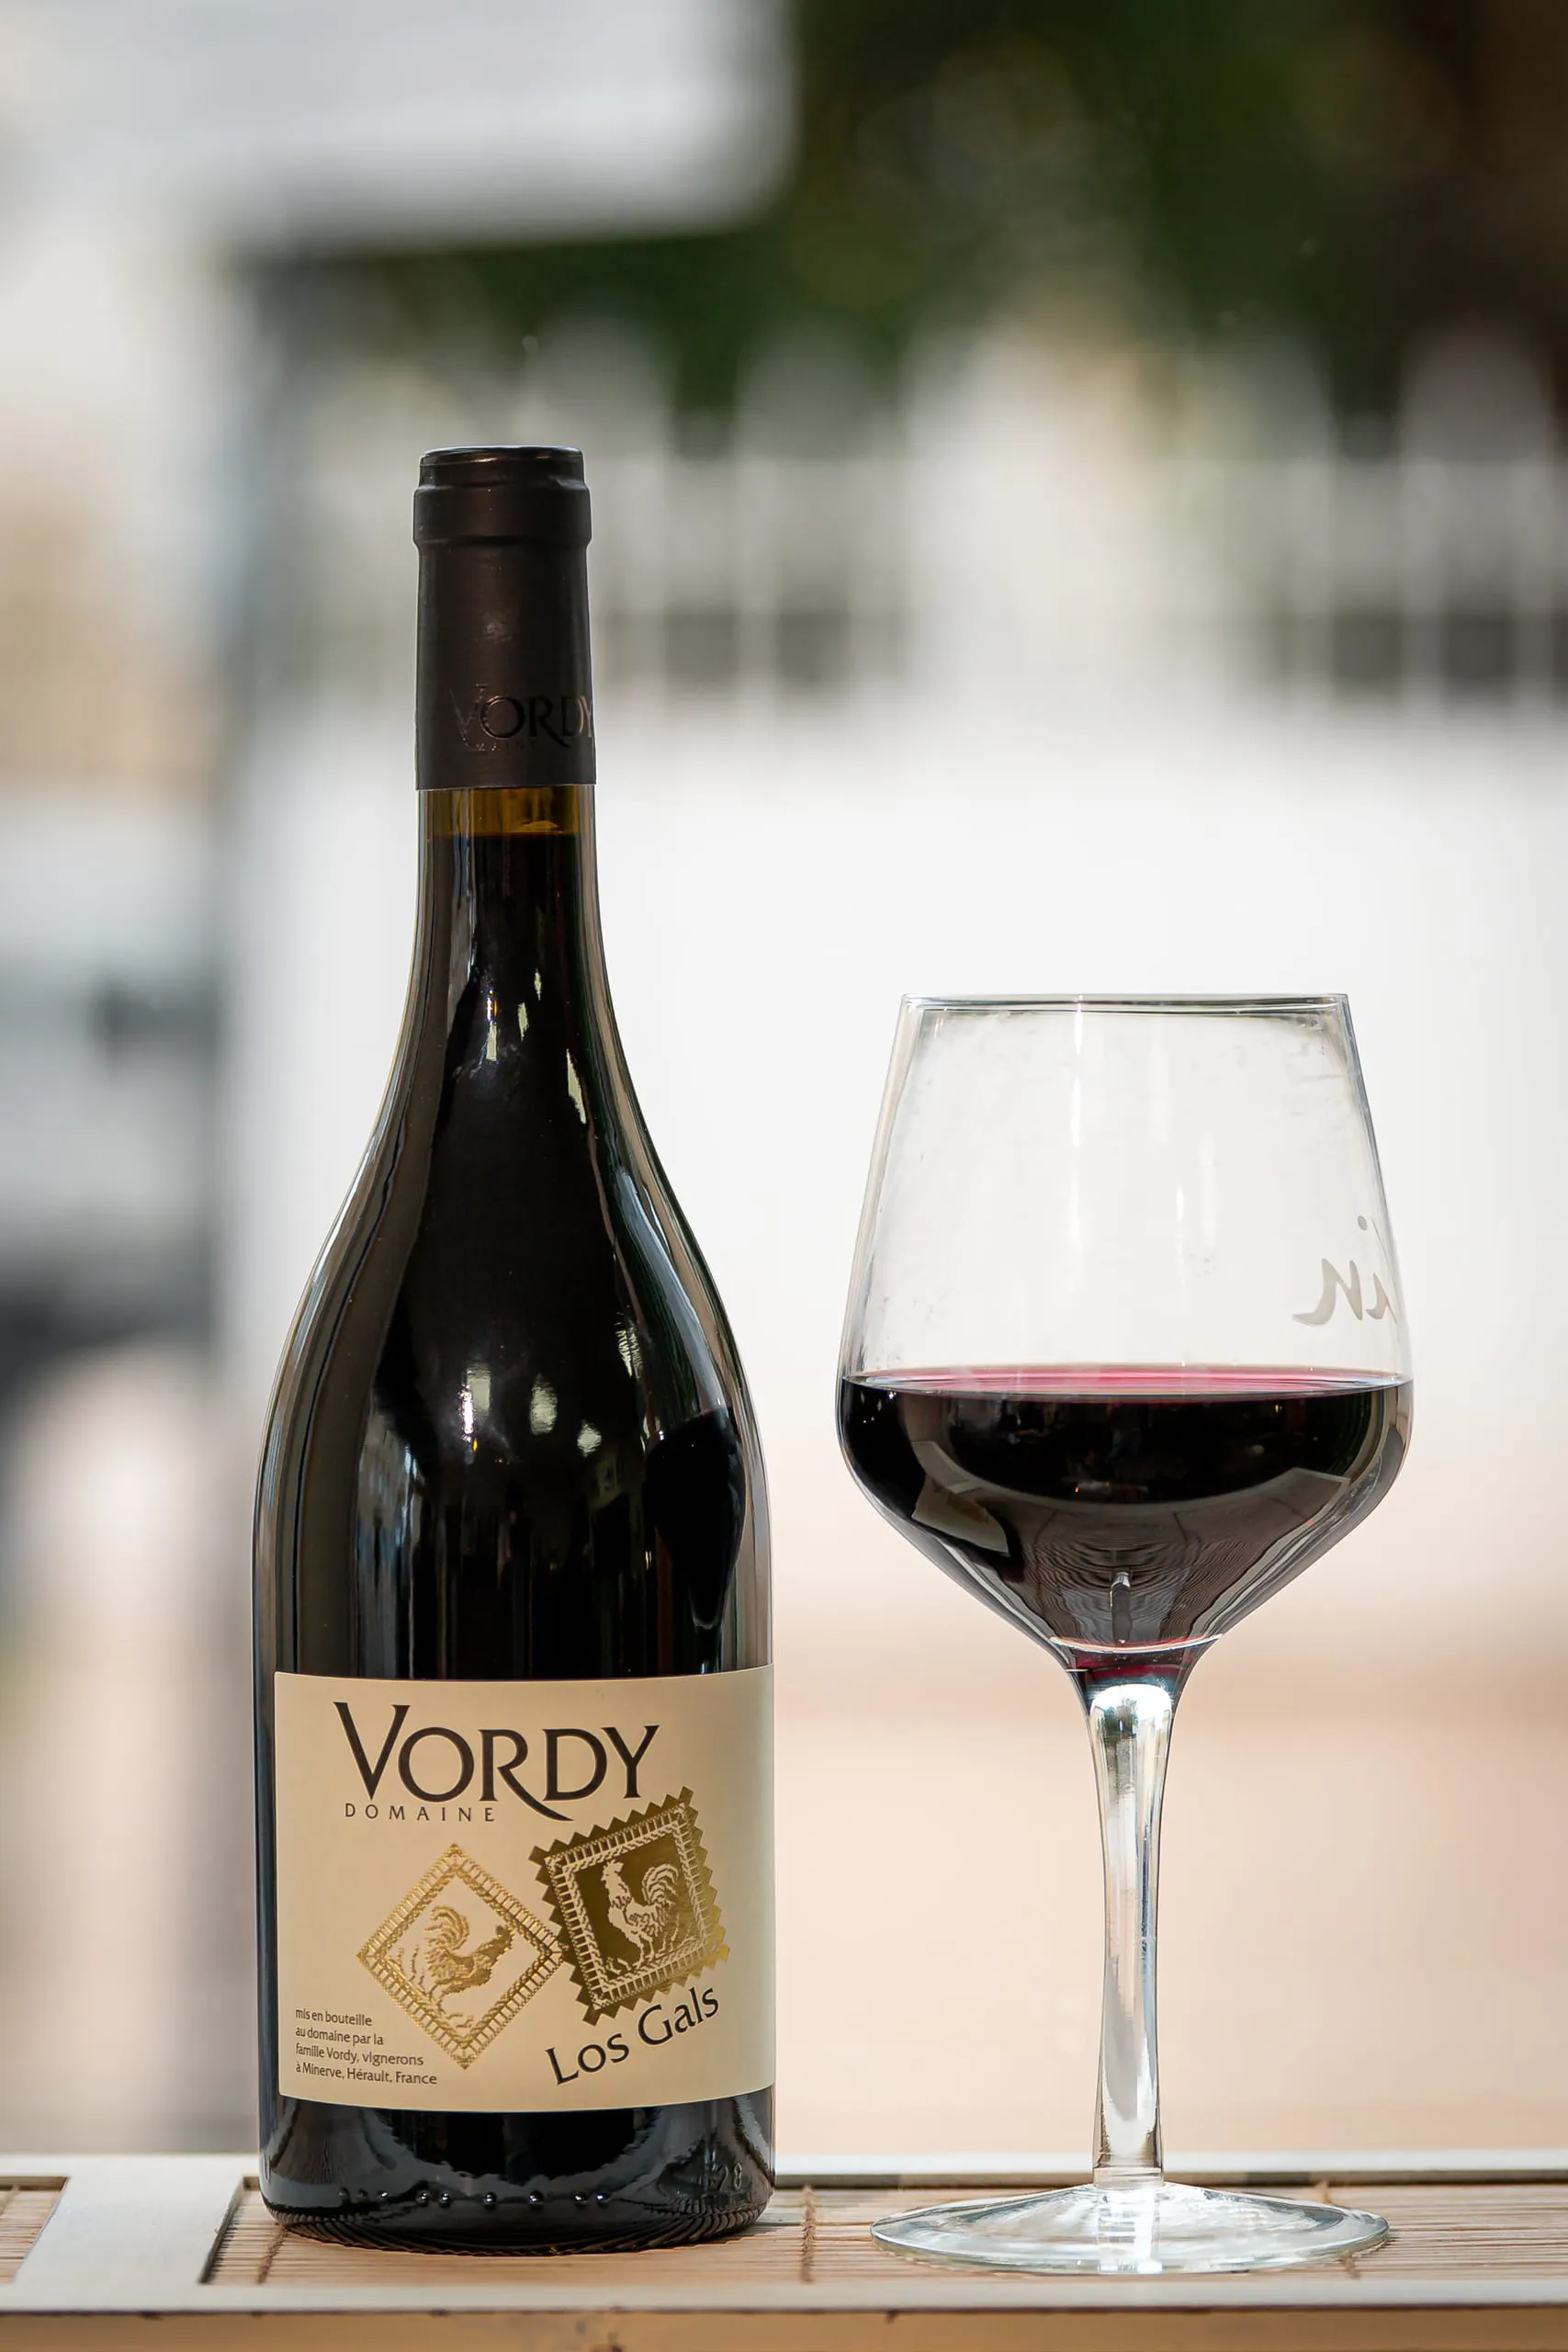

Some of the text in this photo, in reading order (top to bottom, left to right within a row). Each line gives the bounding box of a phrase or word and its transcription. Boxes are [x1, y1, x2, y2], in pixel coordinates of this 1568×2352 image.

[333, 1702, 660, 1821] VORDY
[344, 1803, 495, 1823] DOMAINE
[296, 2008, 372, 2026] mis en bouteille
[296, 2027, 384, 2046] au domaine par la
[545, 1987, 719, 2085] Los Gals
[296, 2042, 424, 2065] famille Vordy, vignerons
[296, 2061, 437, 2084] à Minerve, Hérault, France
